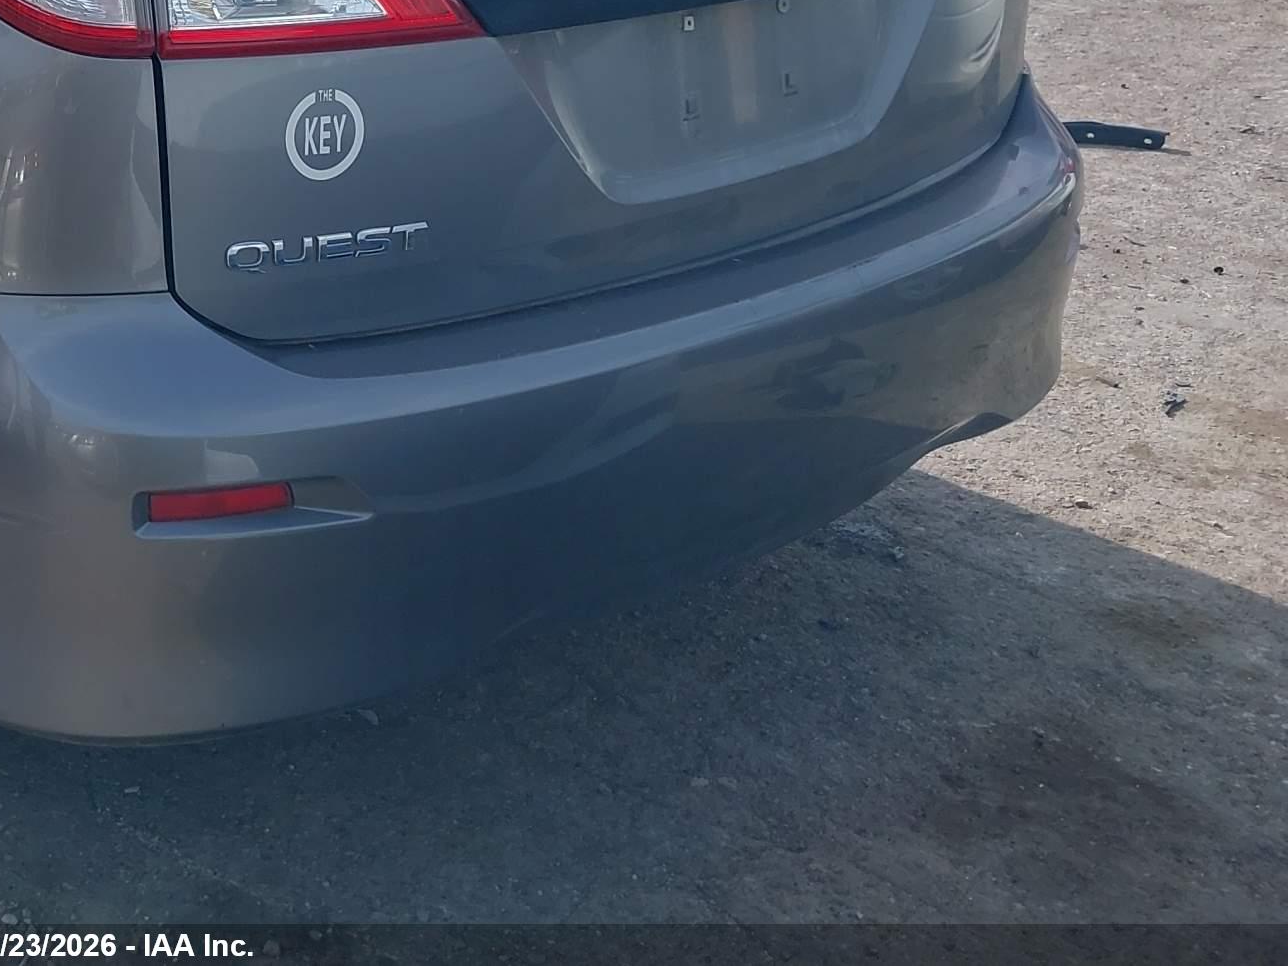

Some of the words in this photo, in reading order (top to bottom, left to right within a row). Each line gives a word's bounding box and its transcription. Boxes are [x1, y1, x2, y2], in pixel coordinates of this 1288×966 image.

[318, 88, 333, 102] THE
[304, 114, 347, 156] KEY
[226, 221, 429, 273] QUEST
